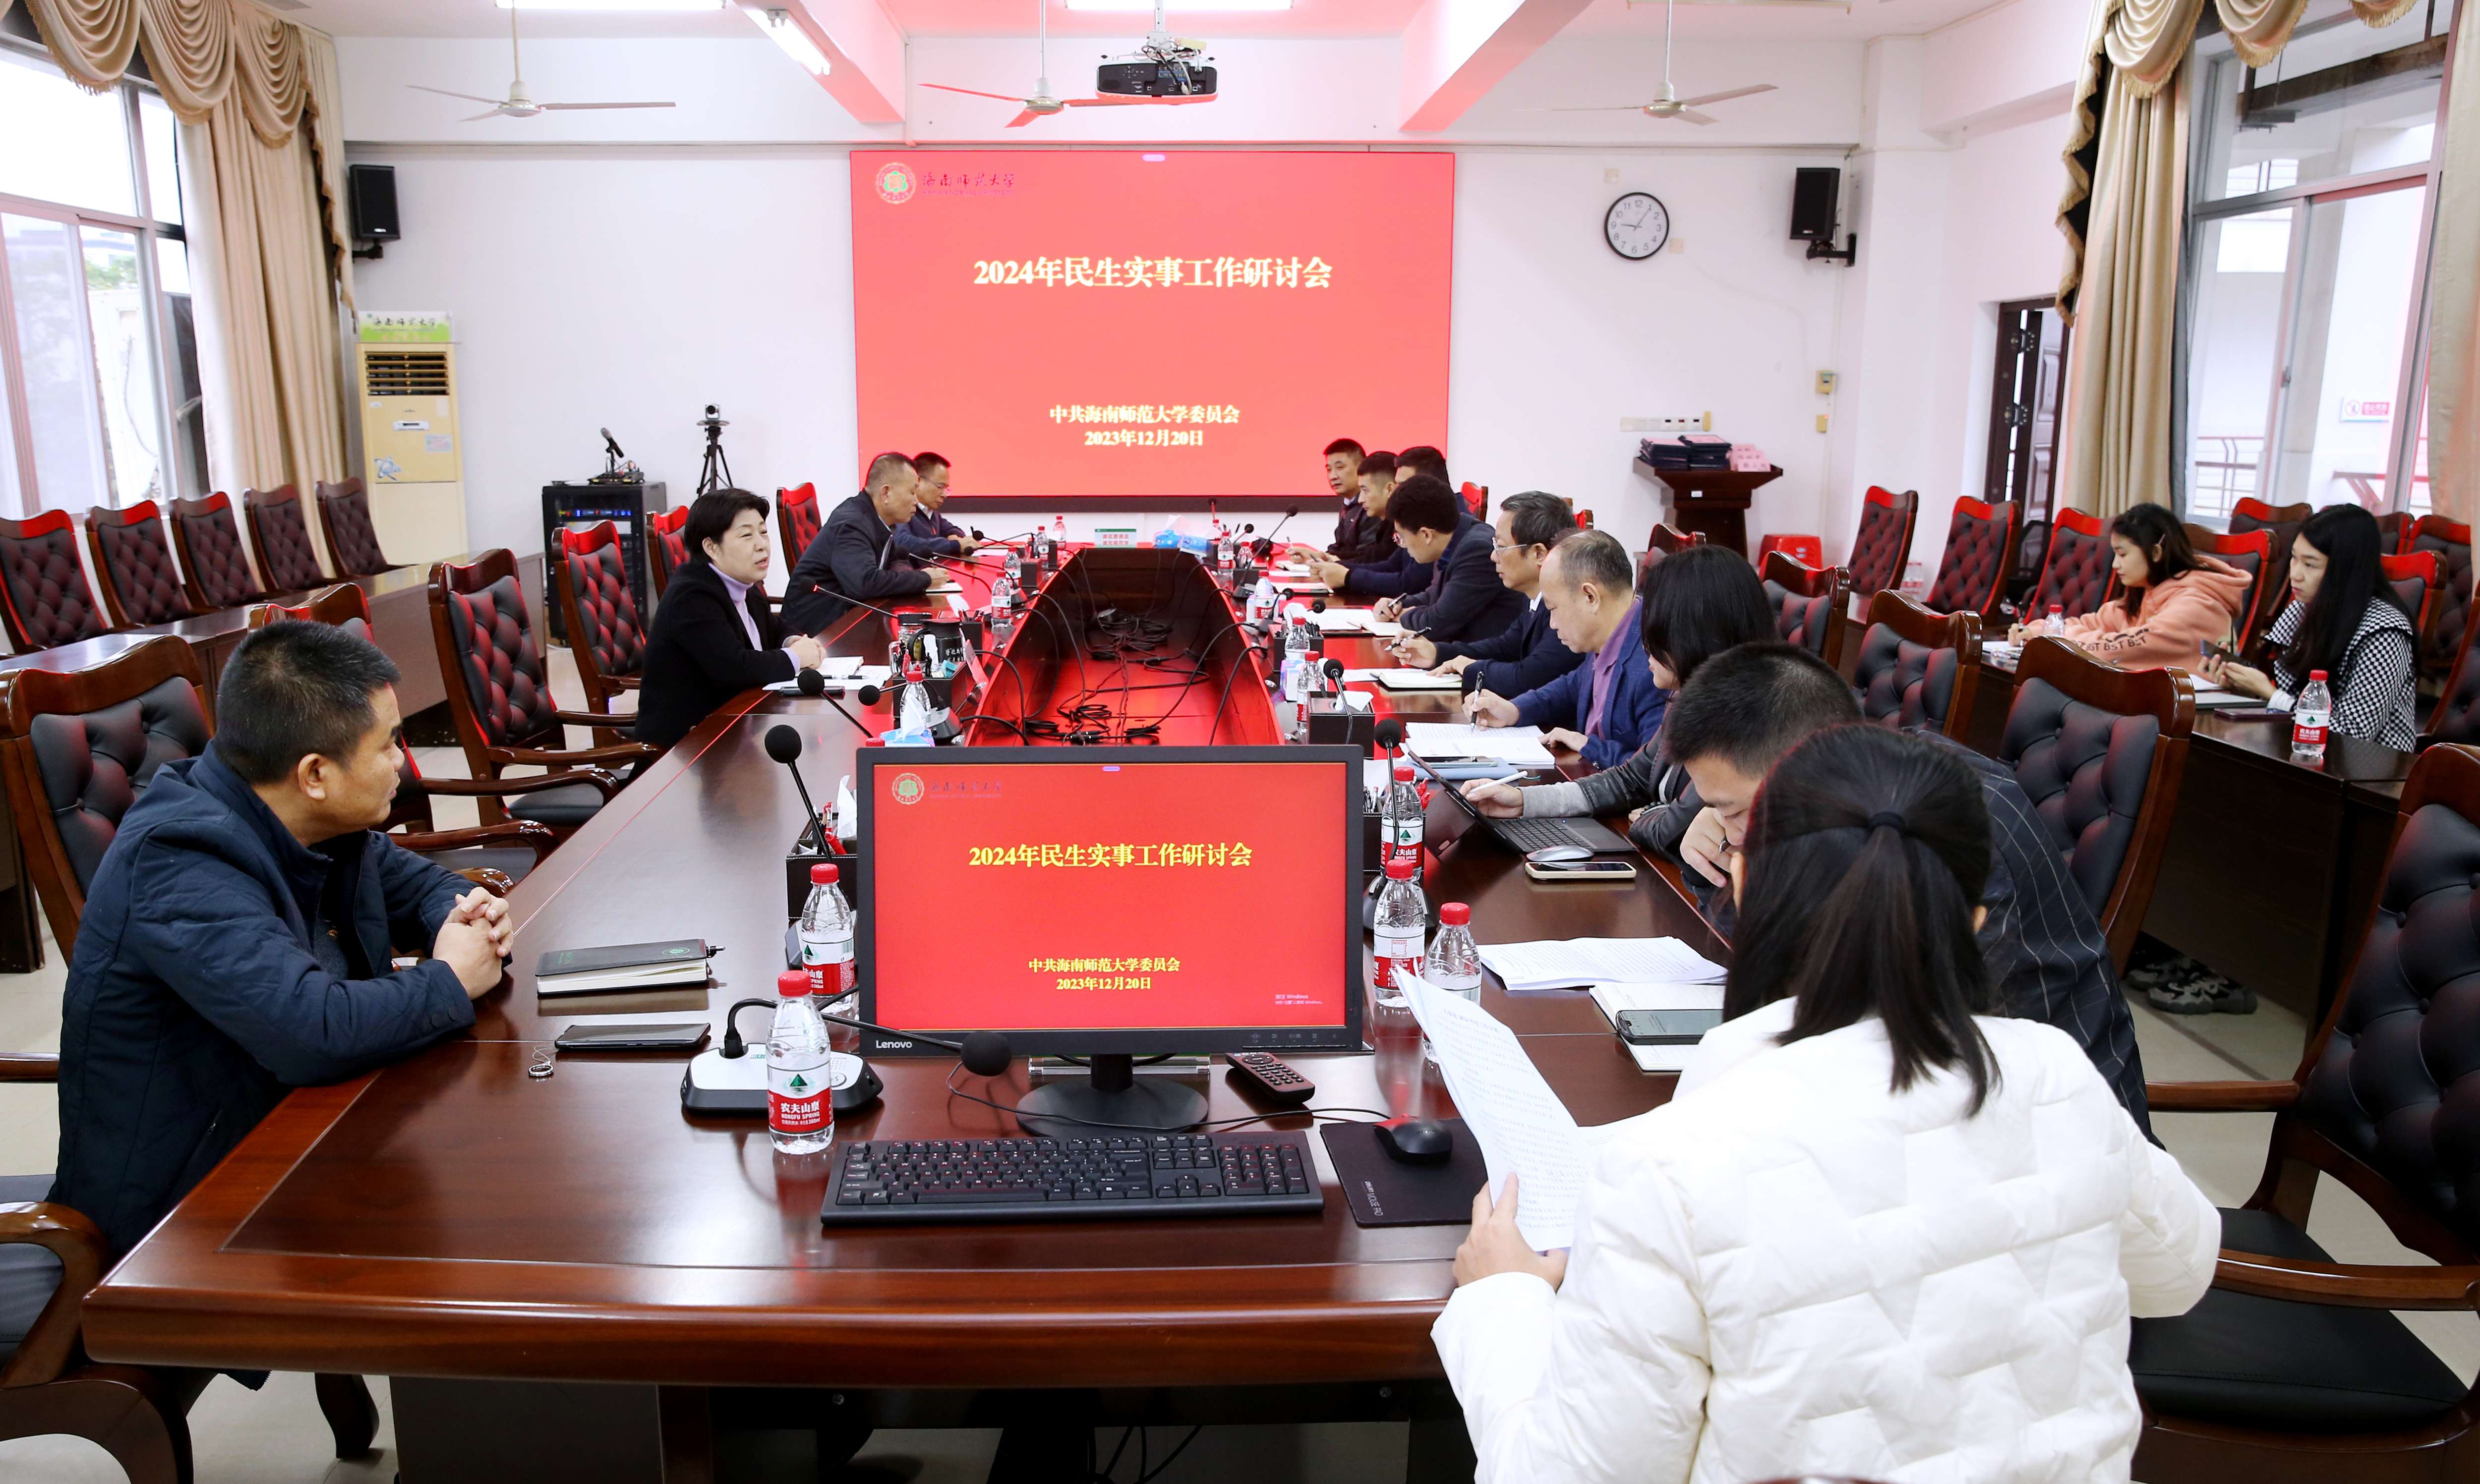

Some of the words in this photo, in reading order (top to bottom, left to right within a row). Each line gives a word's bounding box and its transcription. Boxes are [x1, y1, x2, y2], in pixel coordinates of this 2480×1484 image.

[973, 256, 1333, 288] 2024年民生实事工作研讨会
[1049, 404, 1240, 424] 中共海南师范大学委员会
[1084, 429, 1204, 447] 2023年12月20日
[2104, 641, 2124, 650] BST
[2127, 636, 2146, 647] BST
[969, 842, 1252, 868] 2024年民生实事工作研讨会
[1028, 957, 1181, 973] 中共海南师范大学委员会
[1056, 976, 1152, 991] 2023年12月20日
[876, 1040, 913, 1049] Lenovo
[780, 1100, 820, 1114] 农夫山泉
[1367, 1193, 1380, 1207] MOUSE
[1373, 1207, 1384, 1216] PAD
